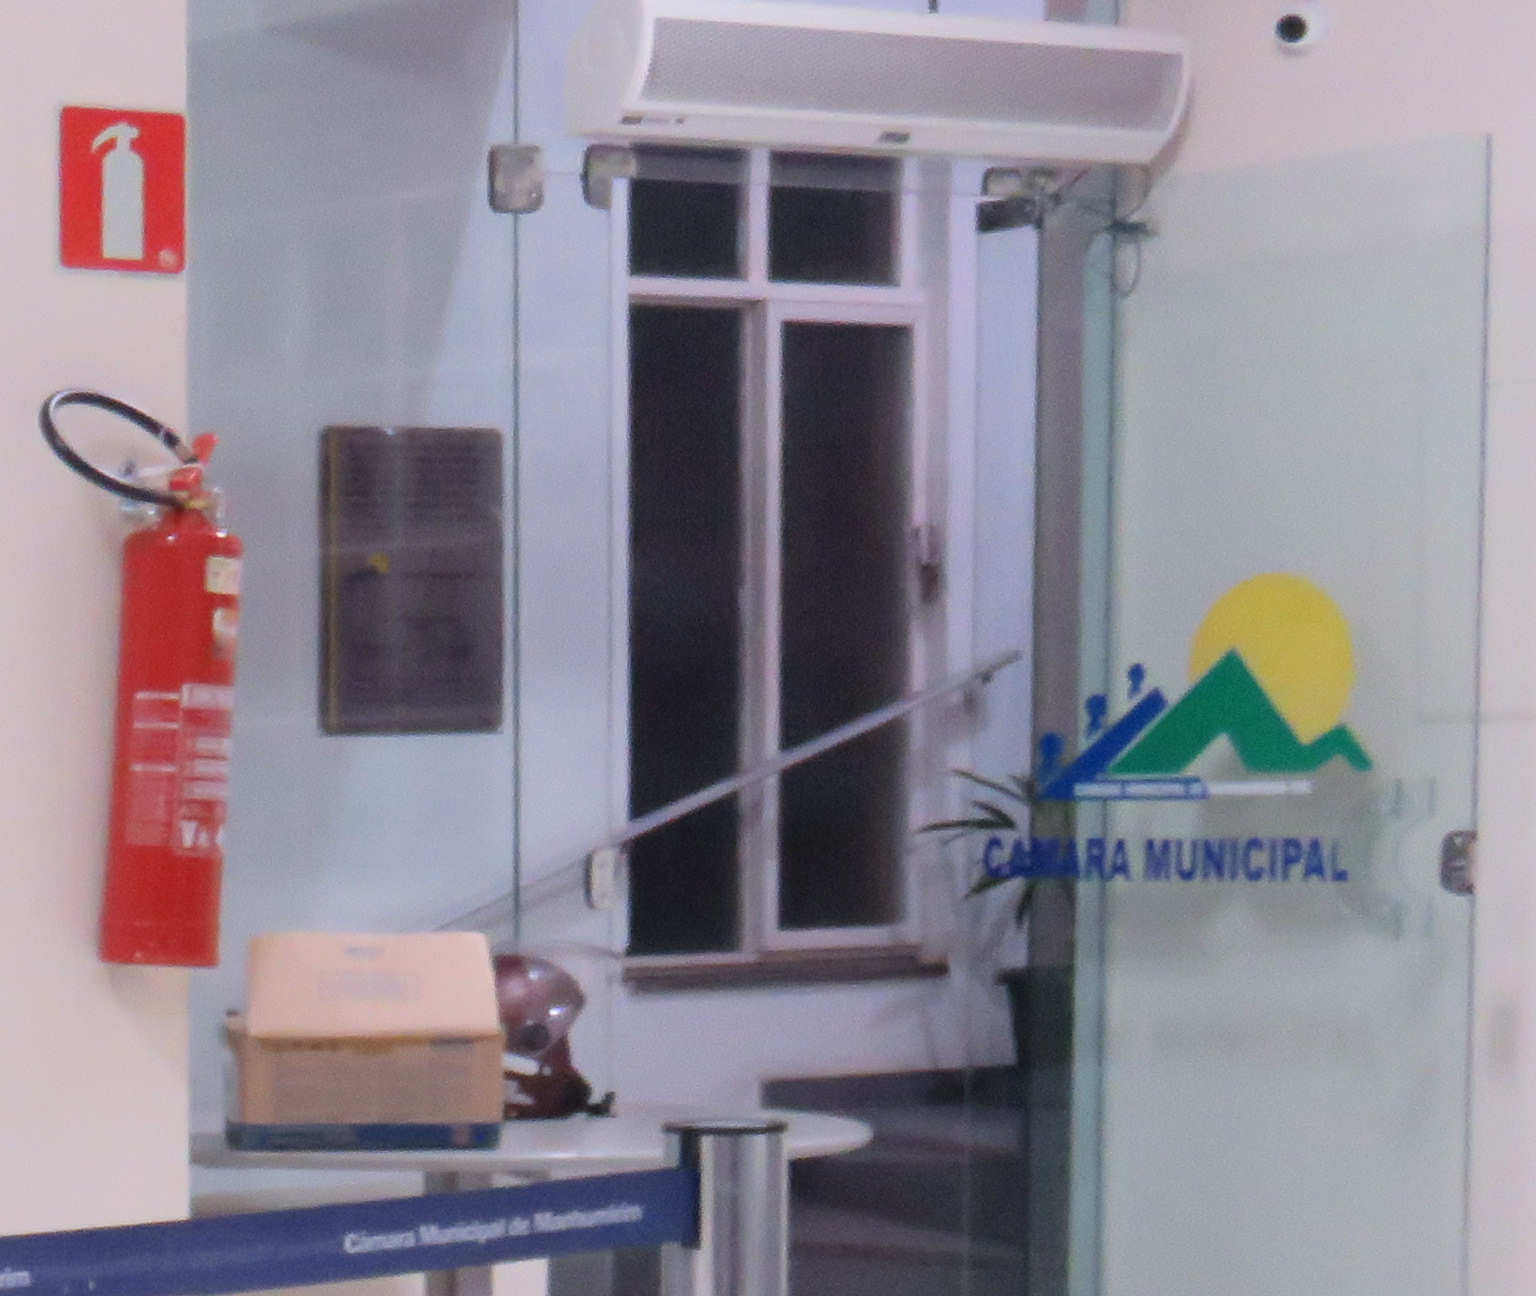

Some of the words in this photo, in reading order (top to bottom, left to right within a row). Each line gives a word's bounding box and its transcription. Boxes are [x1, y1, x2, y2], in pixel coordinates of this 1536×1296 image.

[1144, 837, 1349, 882] MUNICIPAL
[343, 1222, 417, 1253] Câmara
[419, 1217, 507, 1245] Municipal
[508, 1216, 530, 1236] de
